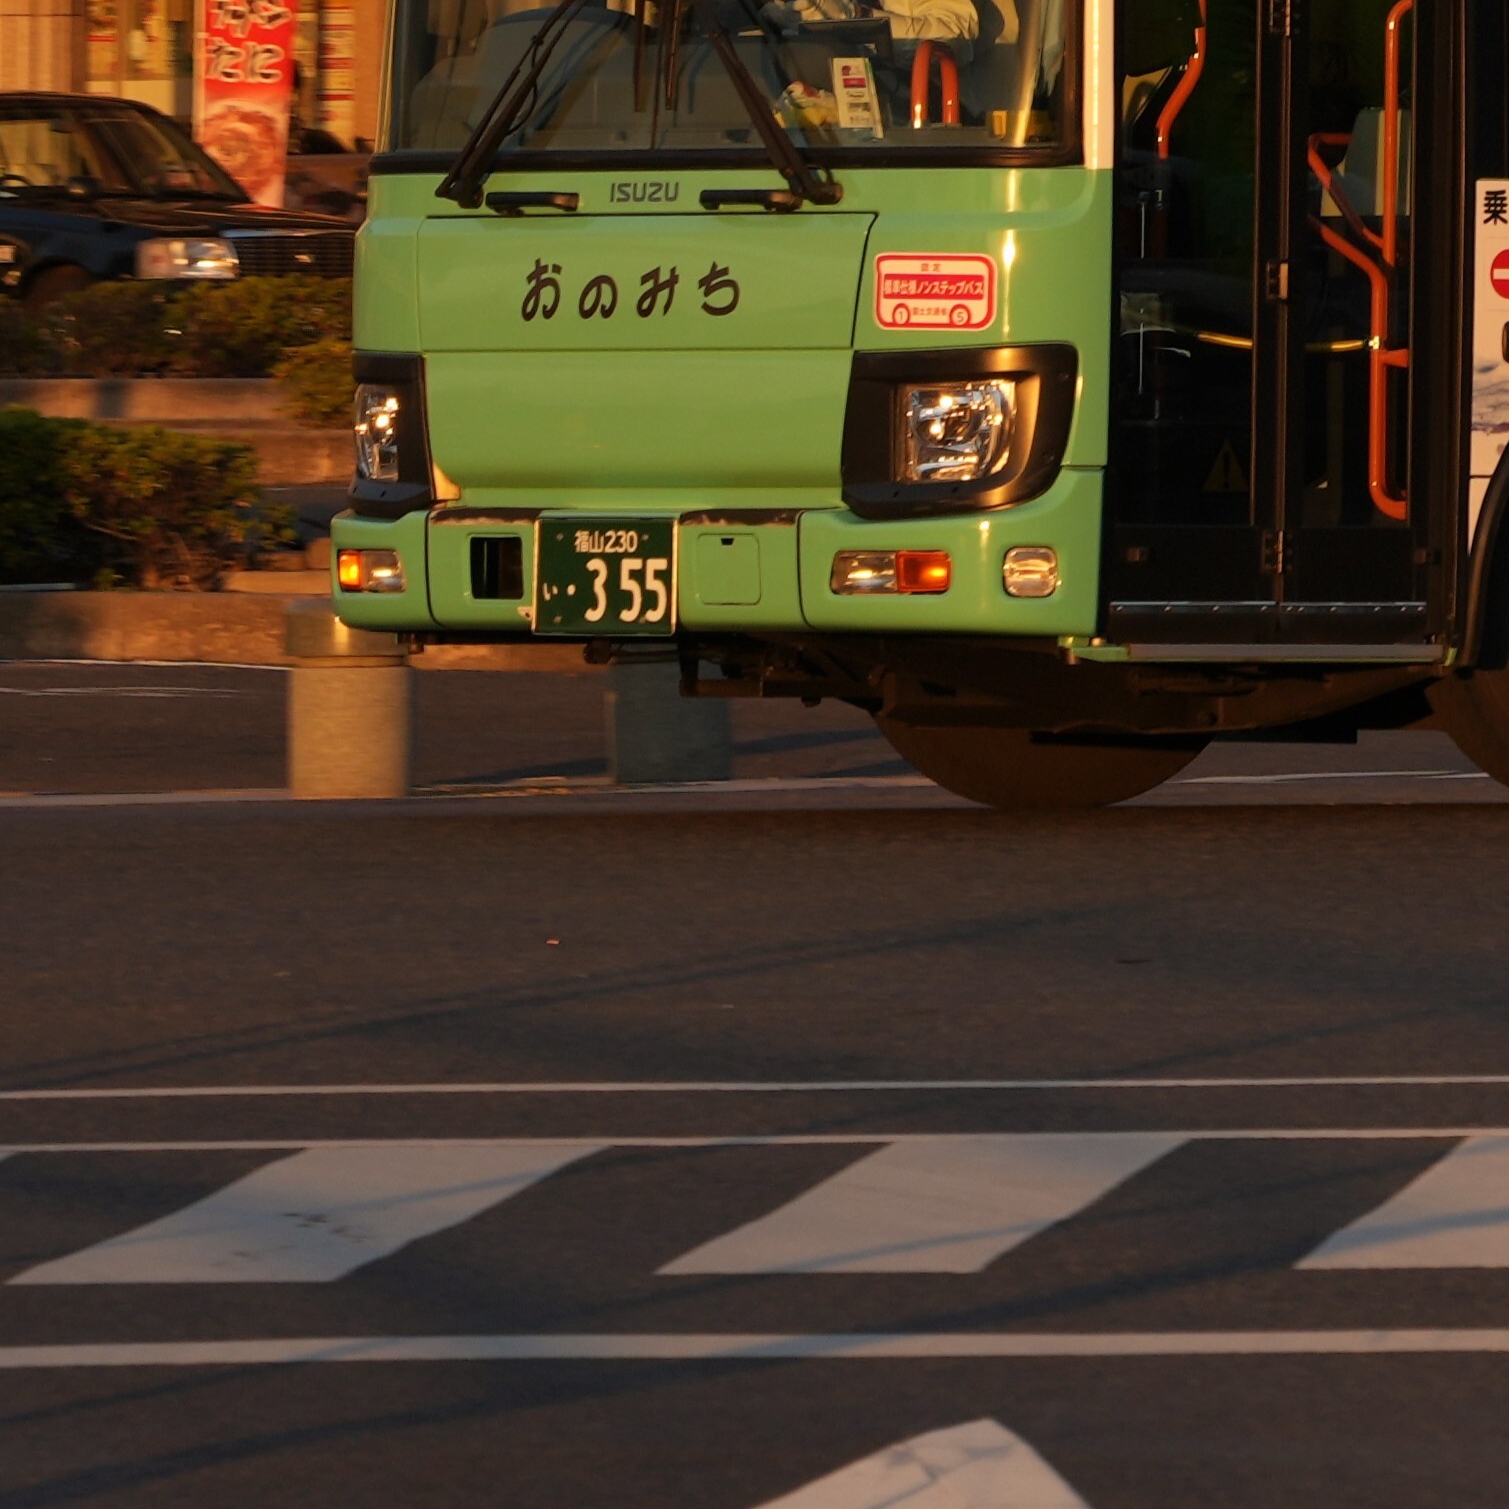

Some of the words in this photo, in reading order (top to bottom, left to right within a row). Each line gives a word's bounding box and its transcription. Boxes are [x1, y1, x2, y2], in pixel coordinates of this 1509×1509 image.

[610, 182, 679, 203] ISUZU
[521, 258, 741, 322] おのみち
